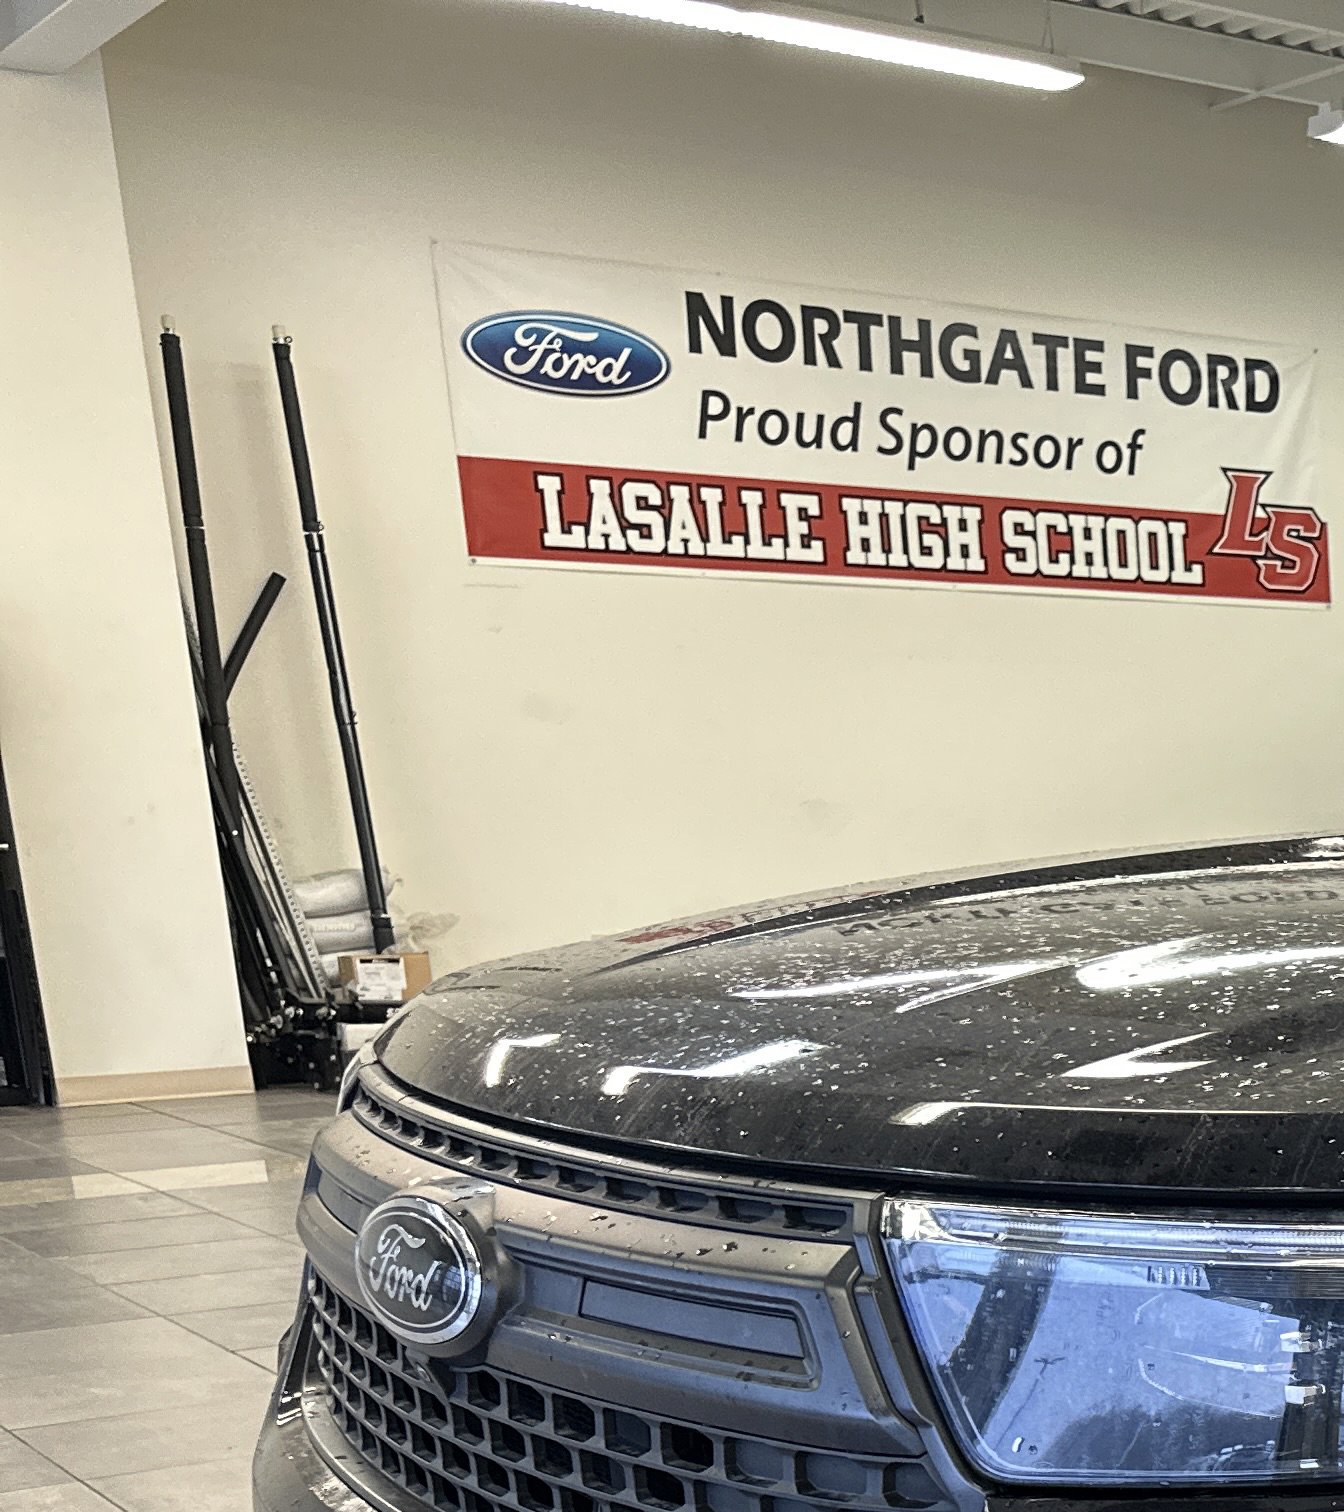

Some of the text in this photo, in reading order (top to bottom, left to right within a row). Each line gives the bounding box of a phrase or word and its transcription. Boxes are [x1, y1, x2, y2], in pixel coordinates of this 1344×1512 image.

[503, 321, 635, 386] Ford
[684, 290, 1281, 414] NORTHGATE FORD
[698, 389, 1147, 476] Proud Sponsor of
[533, 472, 1206, 587] LASALLE HIGH SCHOOL
[1207, 466, 1324, 594] LS
[368, 1223, 442, 1312] Ford
